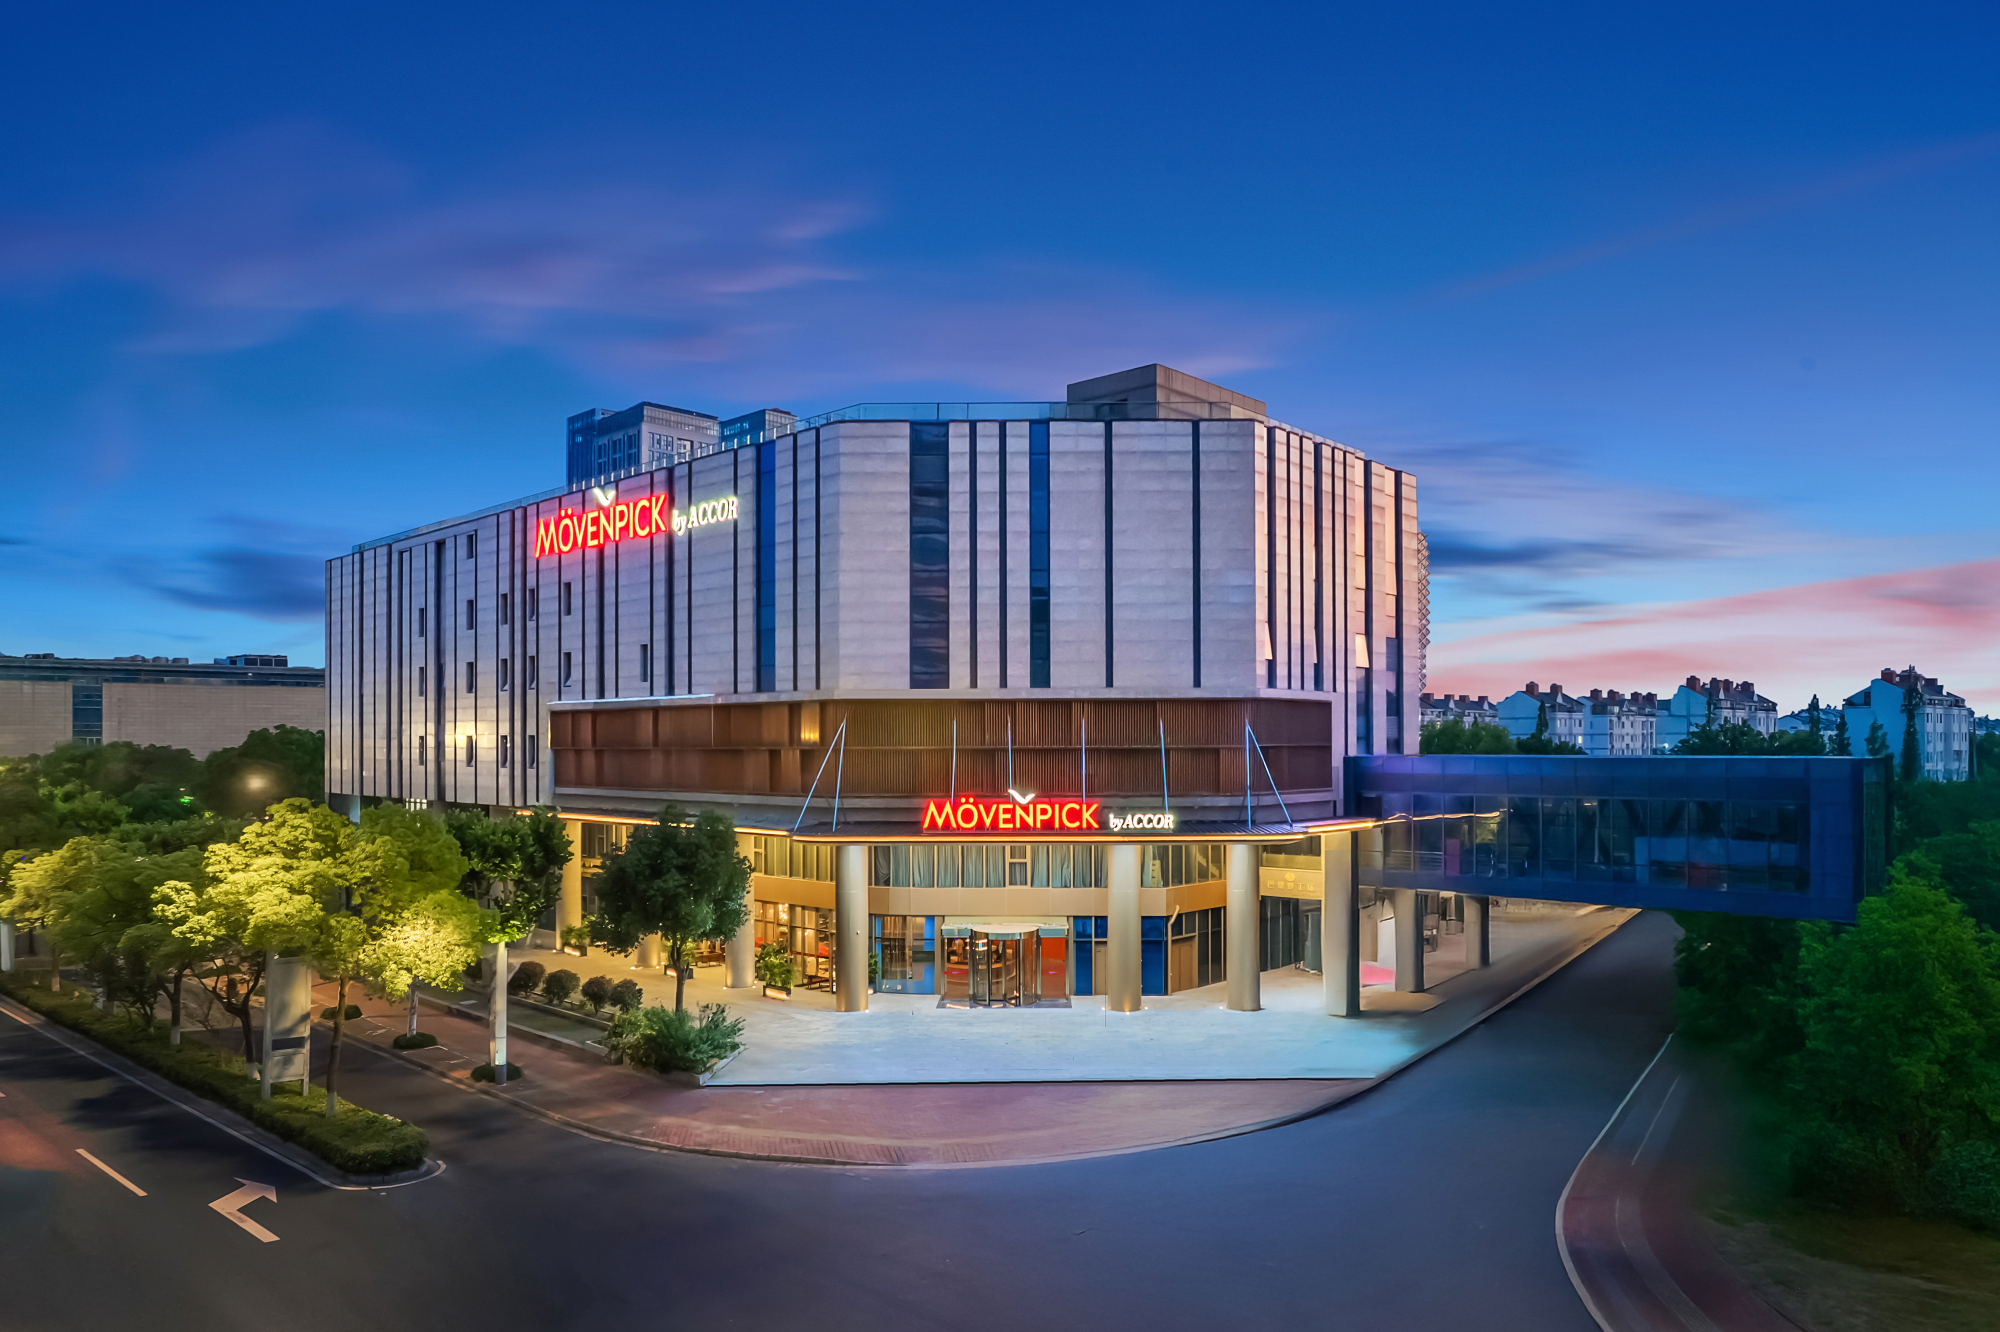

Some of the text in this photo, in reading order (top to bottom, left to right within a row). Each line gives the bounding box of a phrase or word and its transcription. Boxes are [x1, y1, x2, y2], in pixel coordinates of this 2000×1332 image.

[534, 493, 738, 559] MÖVENPICK by ACCOR
[922, 796, 1099, 829] MÖVENPICK
[1122, 813, 1174, 829] ACCOR
